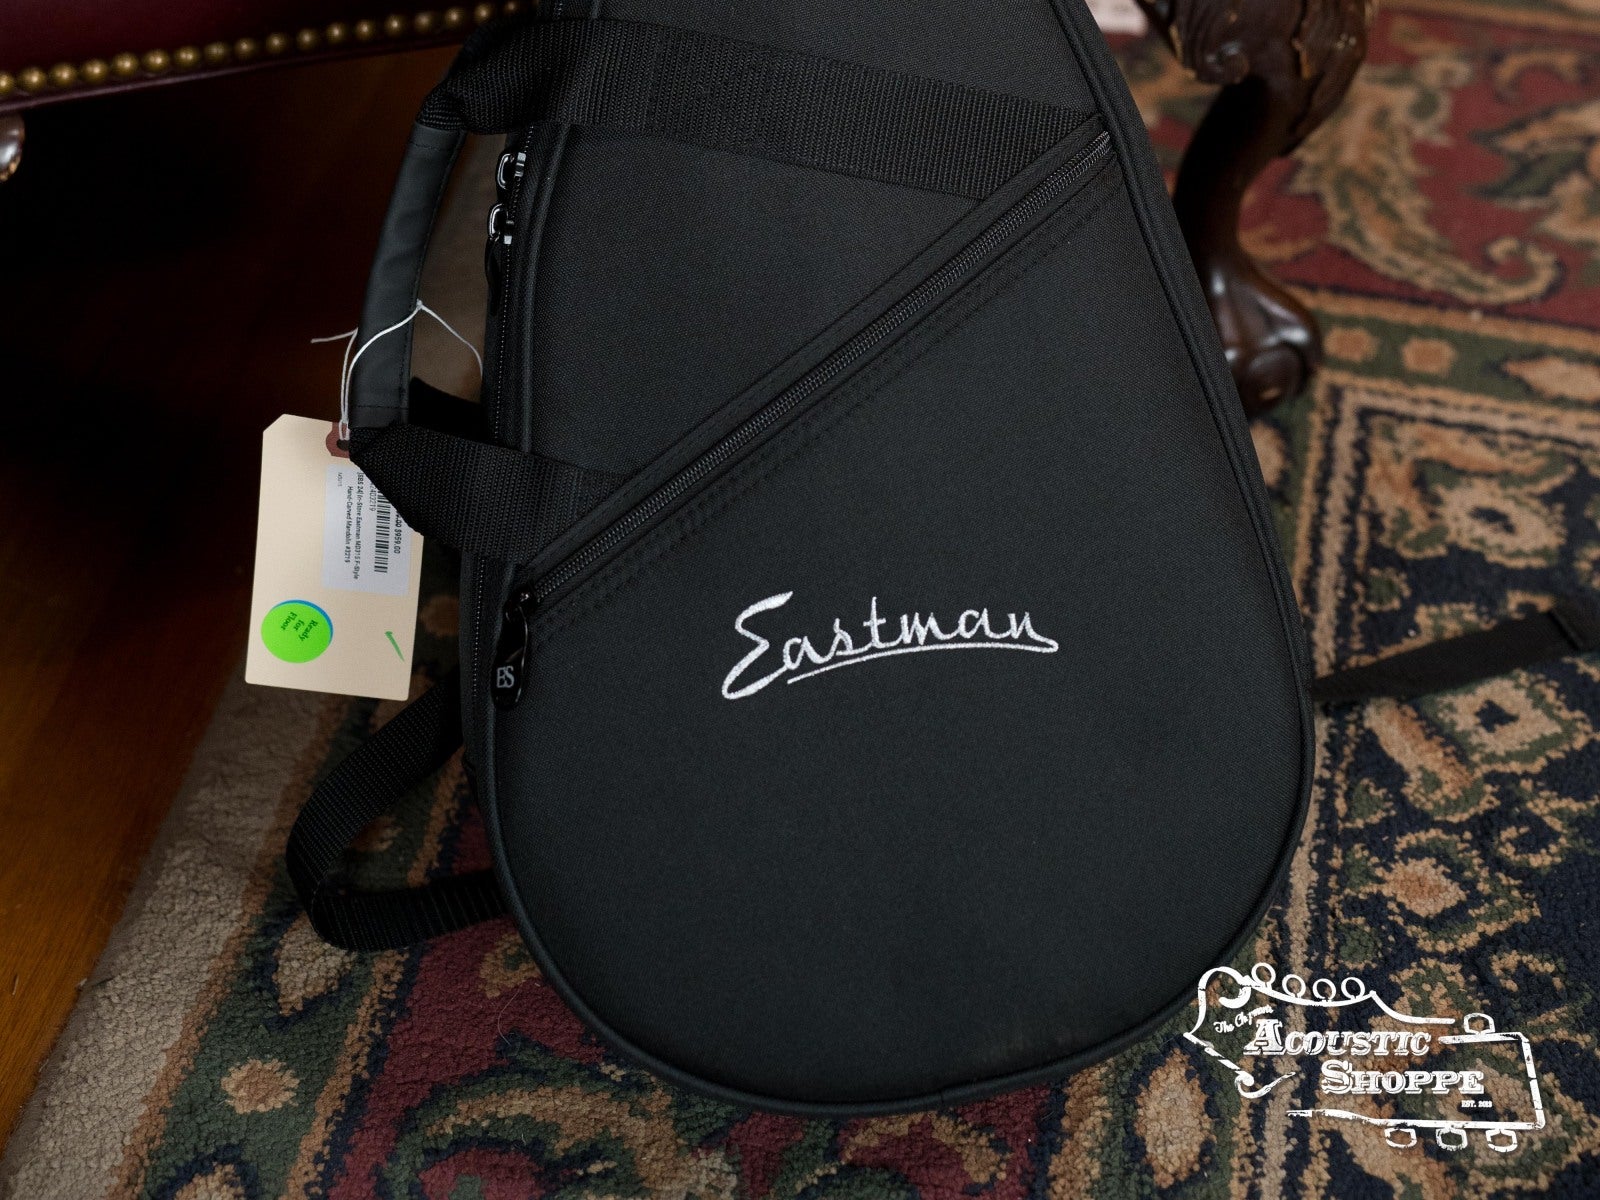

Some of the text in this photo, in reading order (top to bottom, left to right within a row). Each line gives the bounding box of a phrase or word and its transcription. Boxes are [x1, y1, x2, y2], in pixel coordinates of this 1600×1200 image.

[394, 529, 402, 554] $959.00
[281, 612, 297, 630] Floor
[293, 620, 305, 631] for
[299, 619, 318, 641] Ready
[721, 590, 1059, 700] Eastman
